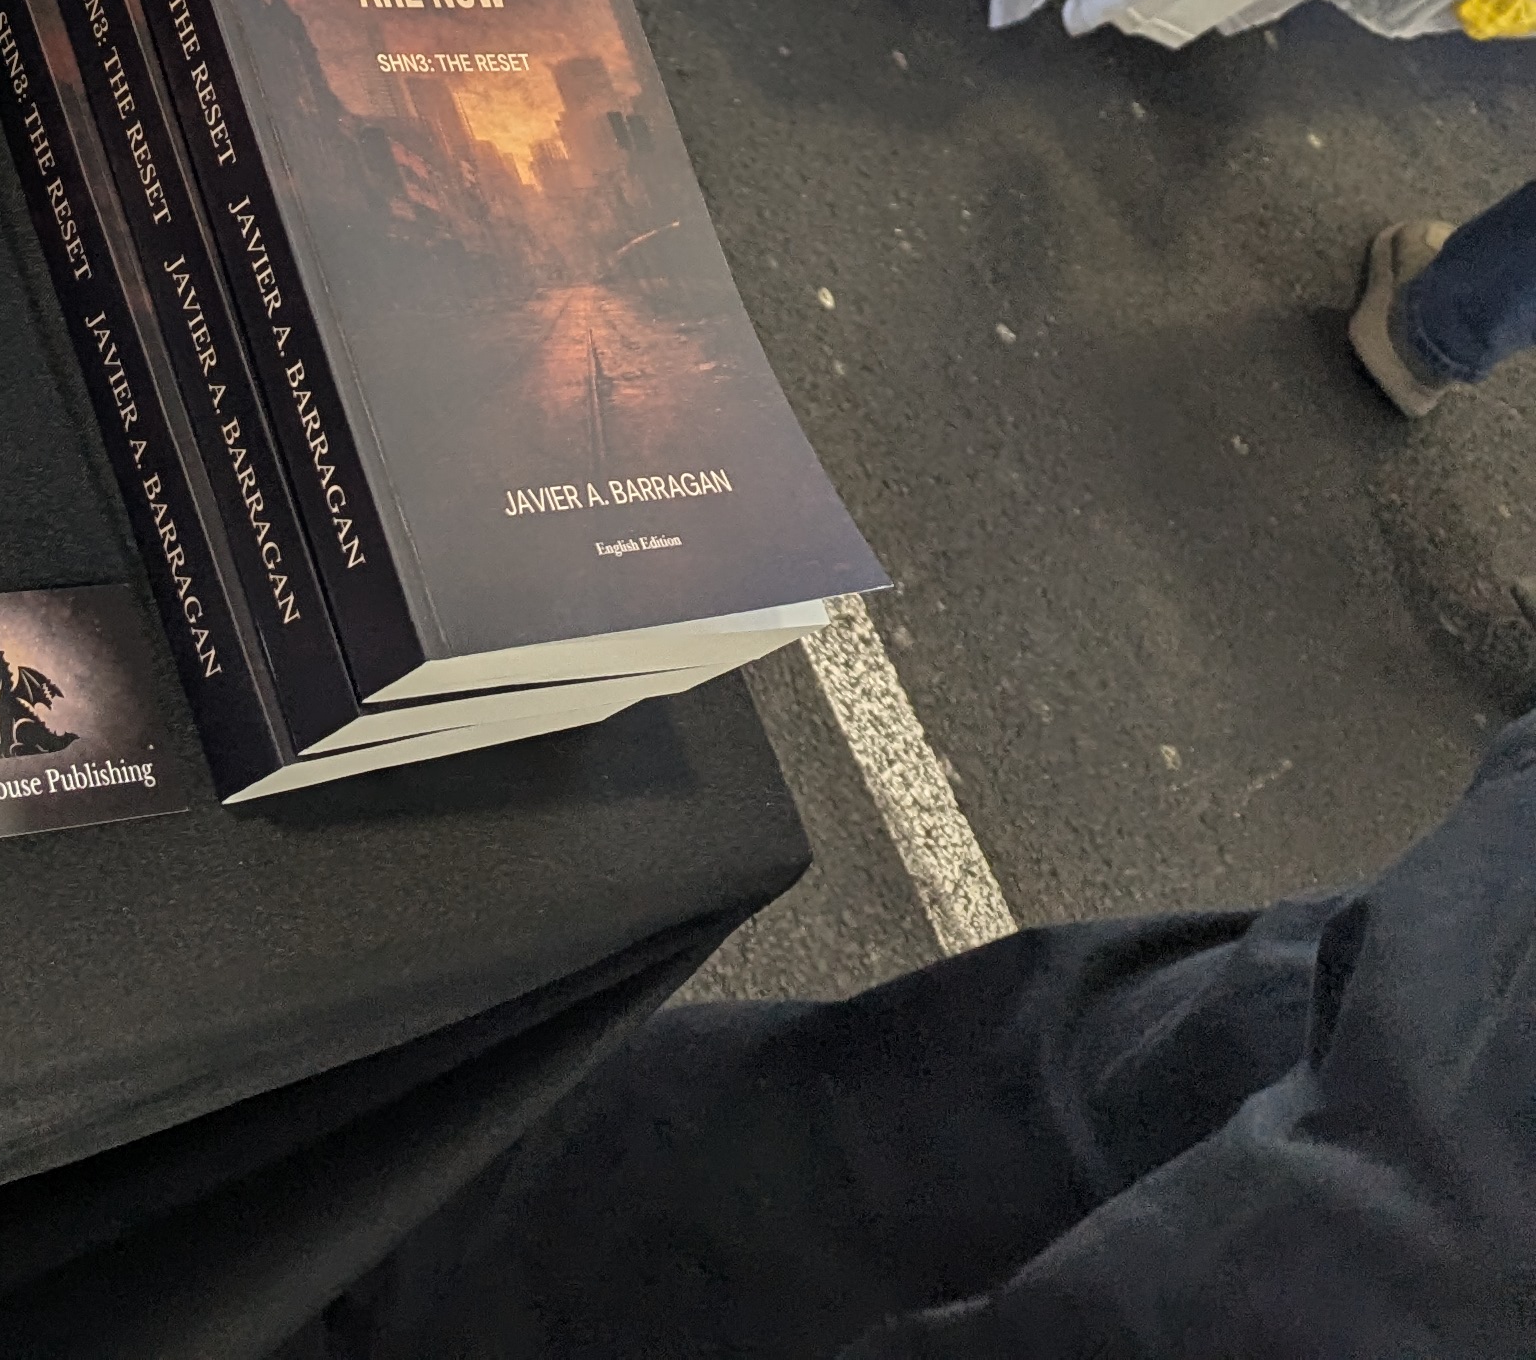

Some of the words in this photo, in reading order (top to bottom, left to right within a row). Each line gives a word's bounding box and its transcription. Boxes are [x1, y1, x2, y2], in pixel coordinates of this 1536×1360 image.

[377, 53, 434, 72] SHN3:
[434, 53, 475, 72] THE
[476, 53, 530, 72] RESET
[102, 46, 135, 120] THE
[125, 120, 173, 226] RESET
[164, 253, 219, 378] JAVIER
[208, 382, 228, 415] A.
[222, 416, 301, 626] BARRAGAN
[191, 61, 239, 167] RESET
[228, 195, 284, 319] JAVIER
[273, 323, 293, 359] A.
[286, 359, 366, 570] BARRAGAN
[23, 102, 58, 176] THE
[46, 177, 94, 281] RESET
[84, 310, 139, 432] JAVIER
[129, 438, 150, 472] A.
[143, 472, 223, 679] BARRAGAN
[505, 484, 583, 516] JAVIER
[586, 482, 610, 507] A.
[608, 469, 733, 505] BARRAGAN
[595, 538, 639, 557] English
[639, 534, 682, 552] Edition
[45, 759, 156, 794] Publishing
